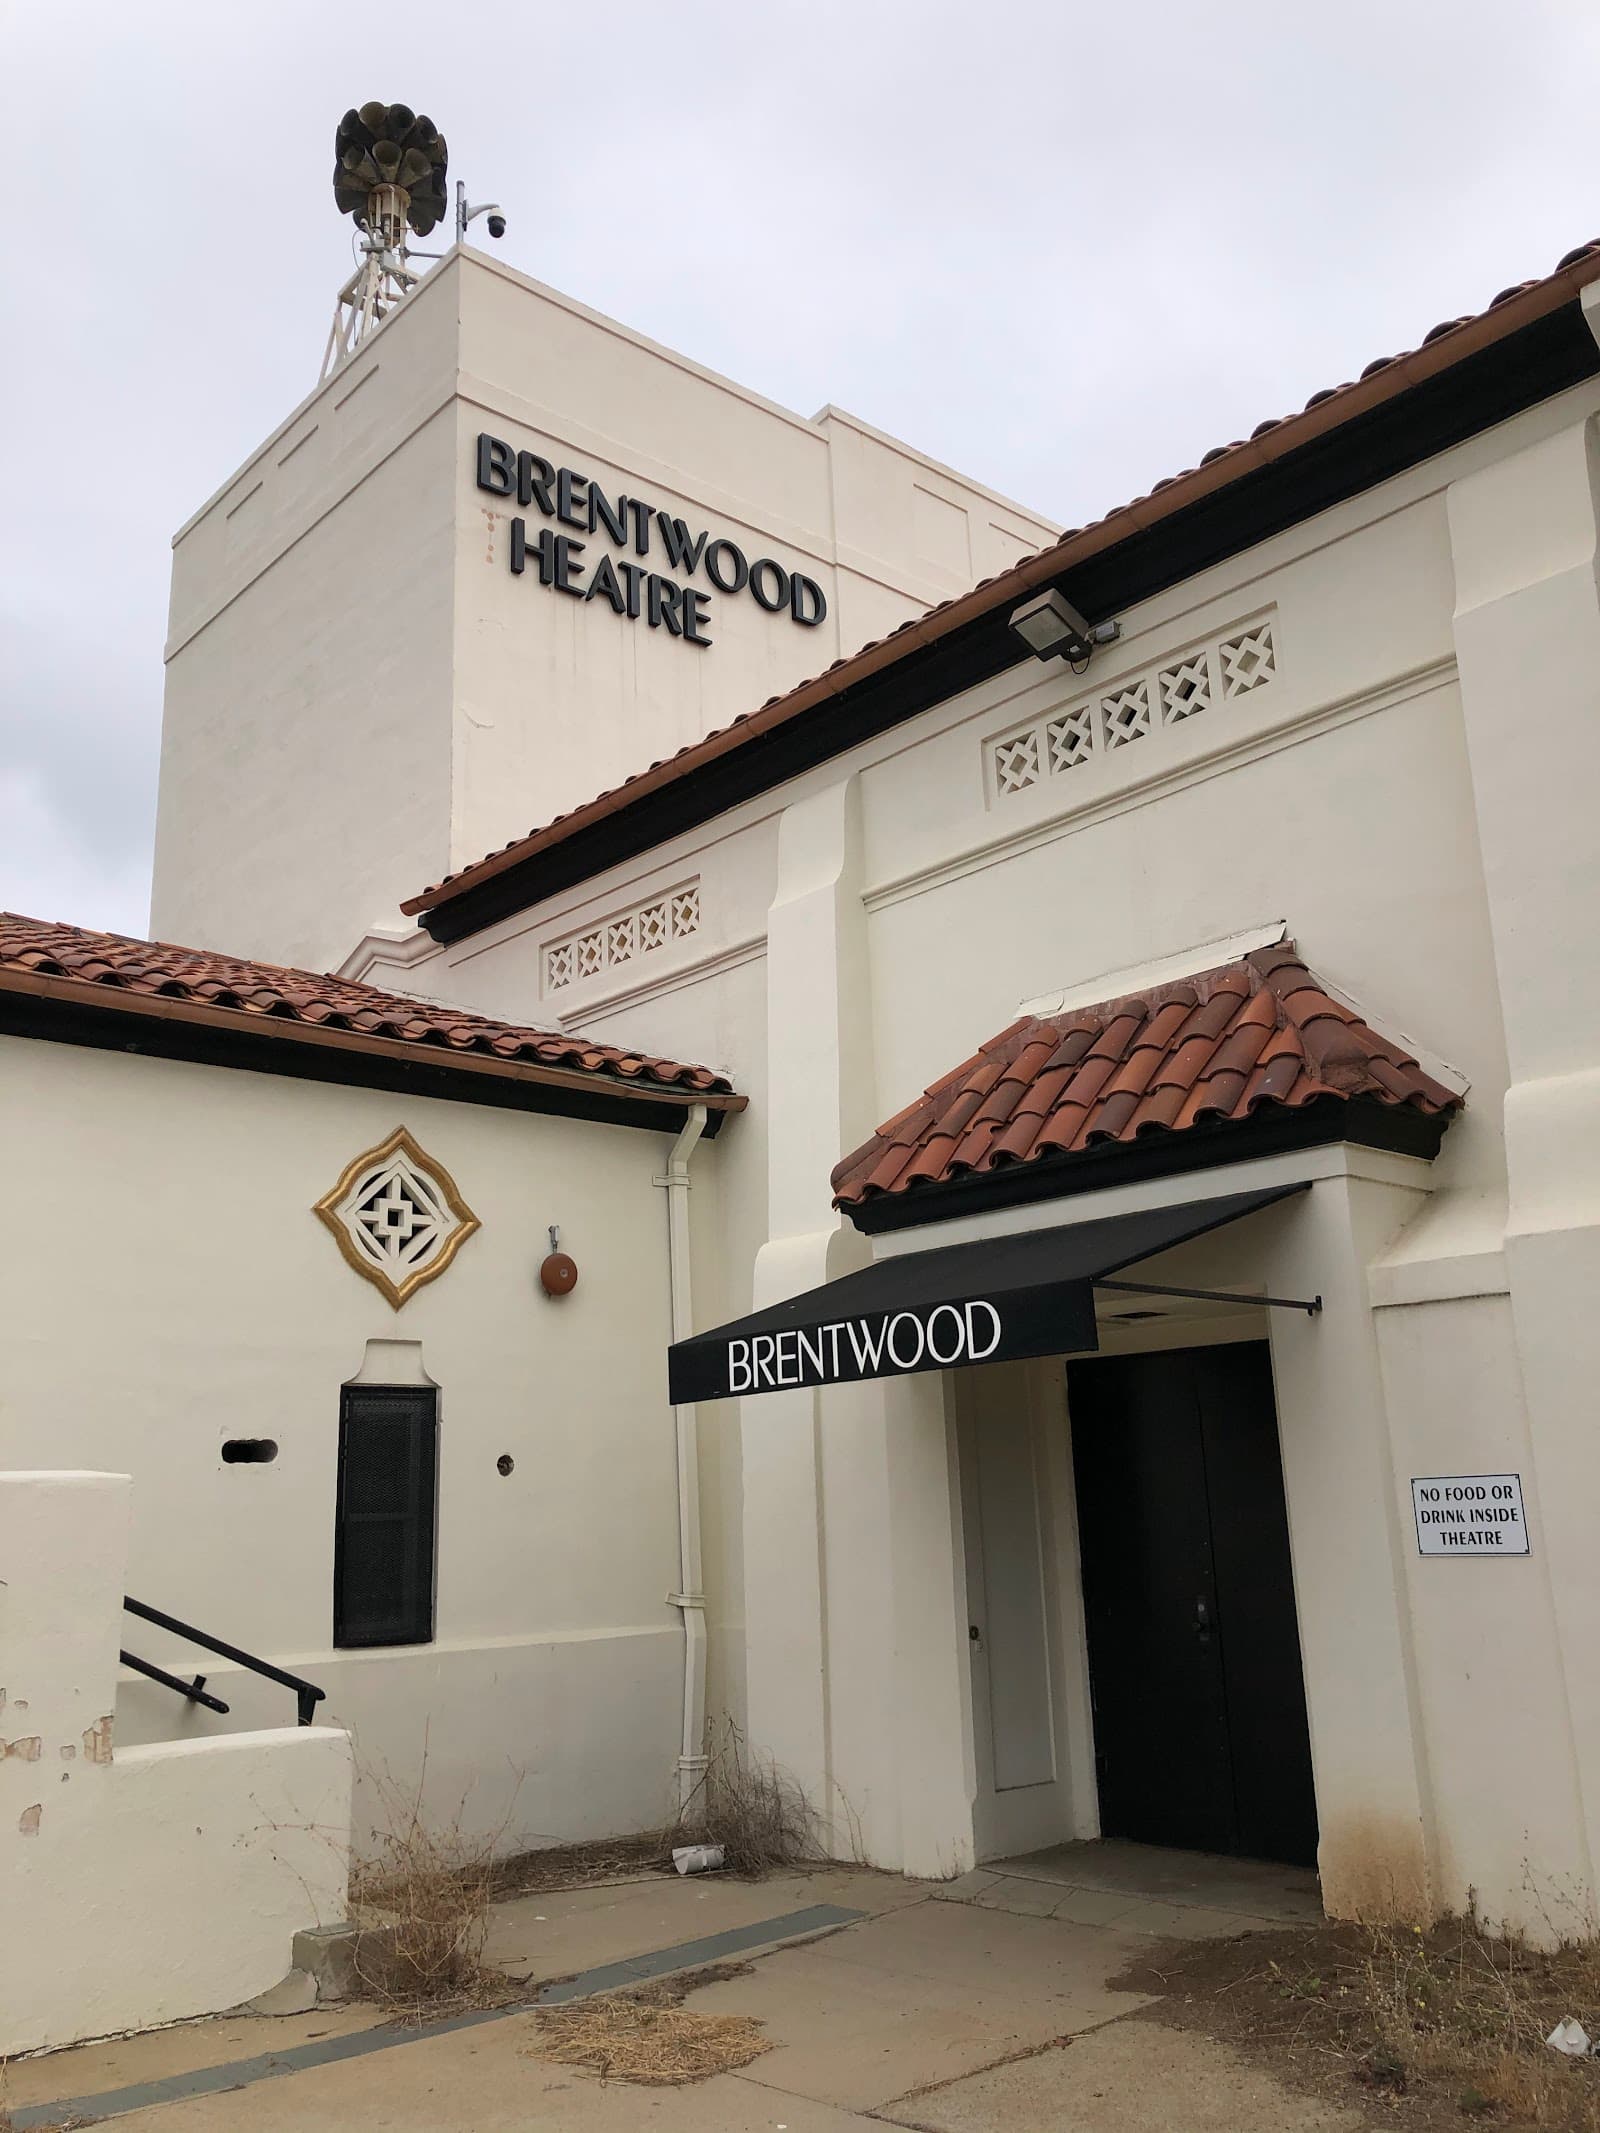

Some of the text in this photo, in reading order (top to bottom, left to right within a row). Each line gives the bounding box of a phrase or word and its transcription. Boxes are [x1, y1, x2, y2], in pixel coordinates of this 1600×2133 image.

[477, 432, 827, 626] BRENTWOOD
[510, 516, 713, 647] HEATRE
[728, 1300, 1001, 1392] BRENTWOOD
[1420, 1485, 1513, 1501] NO FOOD OR
[1420, 1508, 1519, 1523] DRINK INSIDE
[1440, 1531, 1503, 1545] THEATRE
